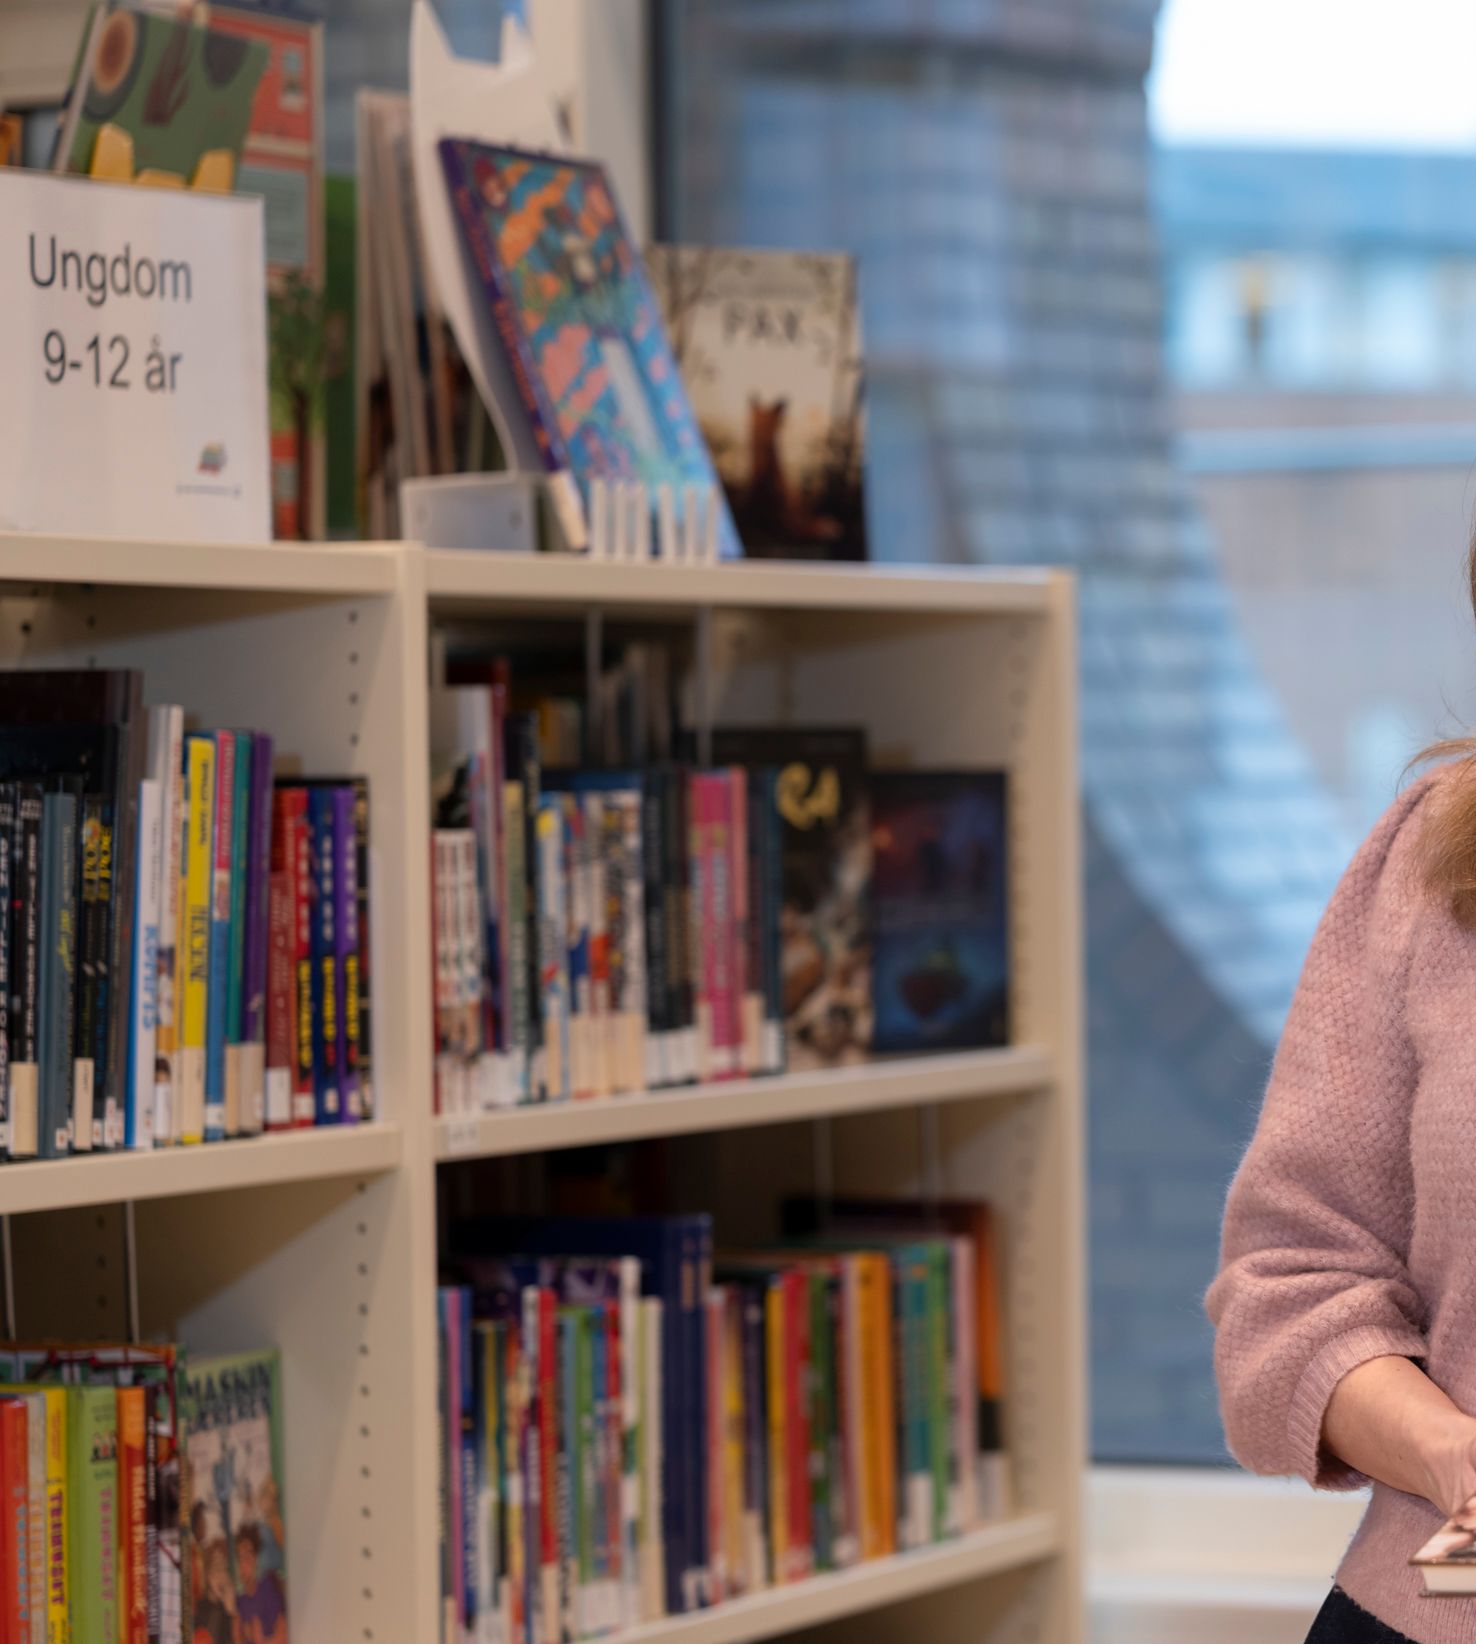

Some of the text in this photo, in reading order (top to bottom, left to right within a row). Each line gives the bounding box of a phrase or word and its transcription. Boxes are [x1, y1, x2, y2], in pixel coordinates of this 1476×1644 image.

[28, 233, 193, 307] Ungdom
[722, 306, 803, 342] PAX
[43, 330, 182, 394] 9-12 år
